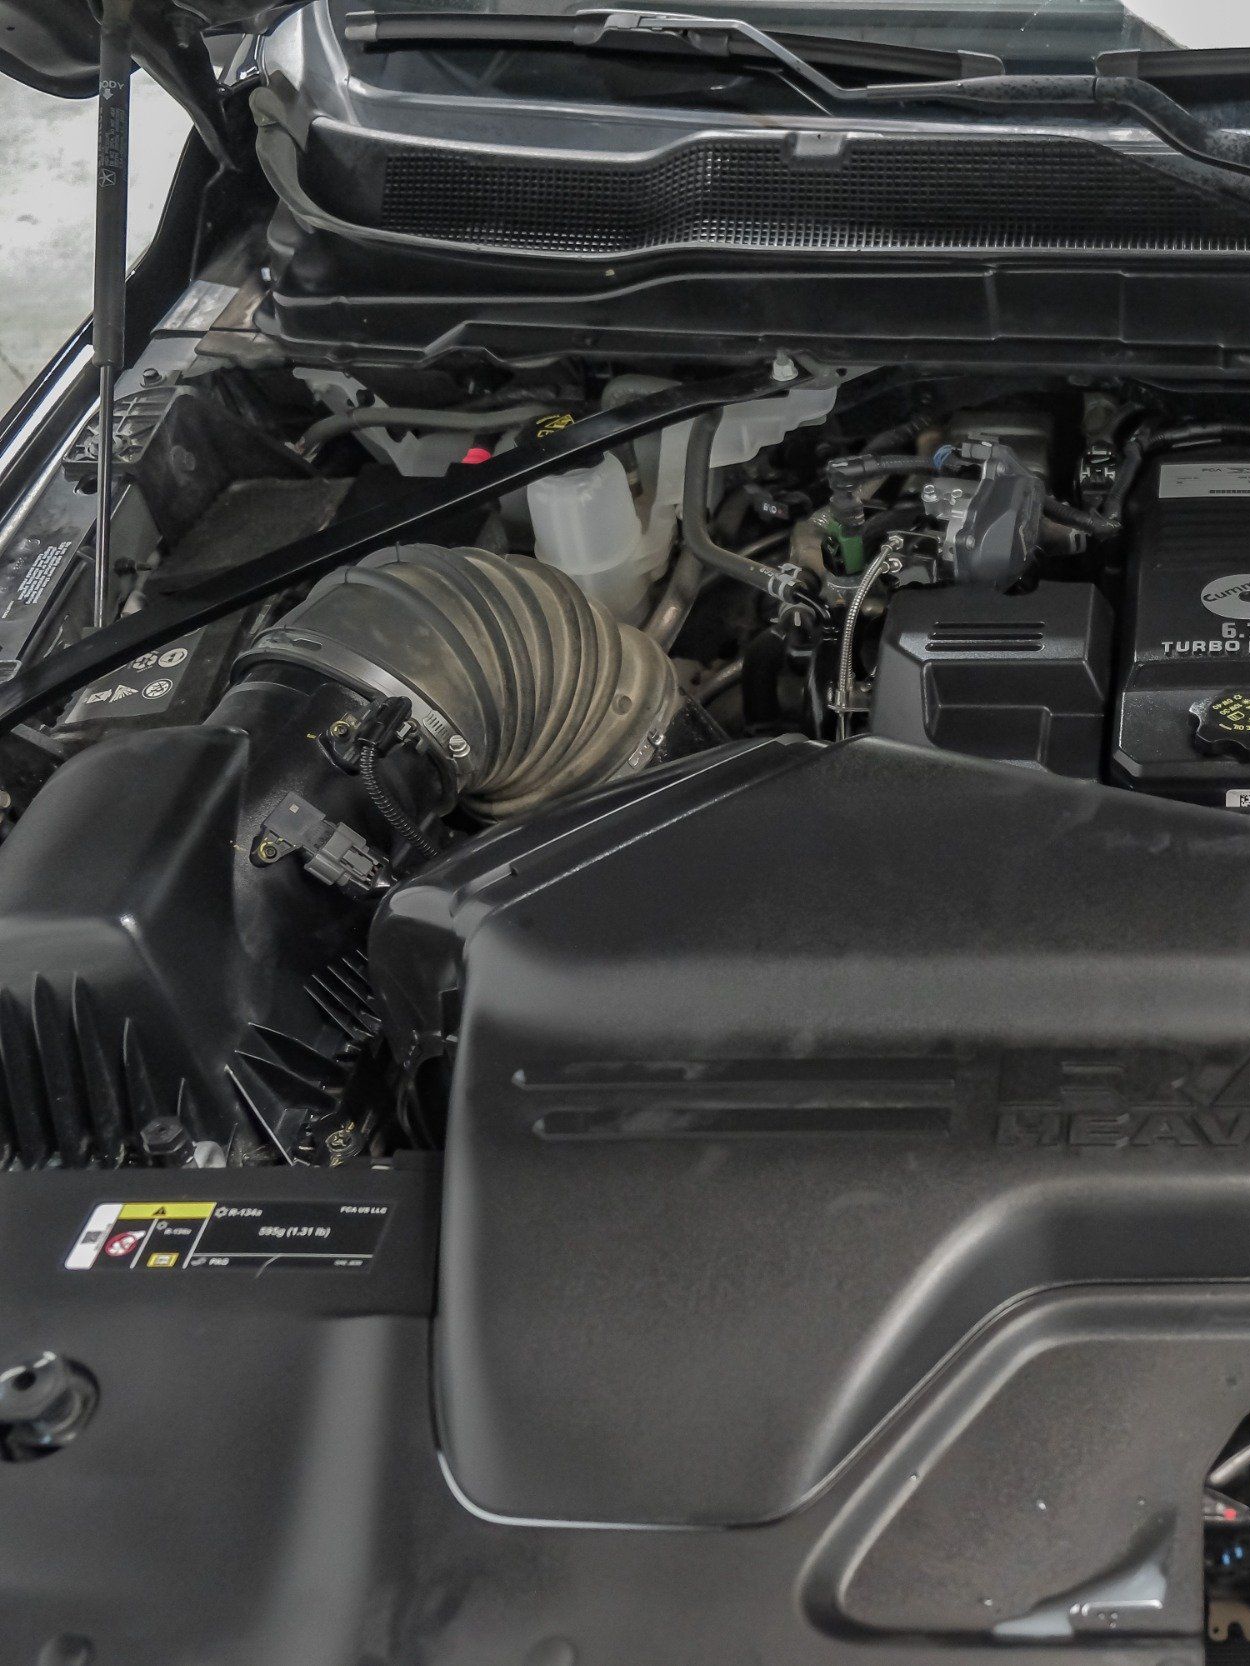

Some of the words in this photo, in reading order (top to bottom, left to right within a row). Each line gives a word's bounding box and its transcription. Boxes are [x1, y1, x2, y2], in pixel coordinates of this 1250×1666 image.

[1161, 640, 1241, 653] TURBO
[286, 1226, 314, 1238] (1.31
[314, 1226, 331, 1239] lb)
